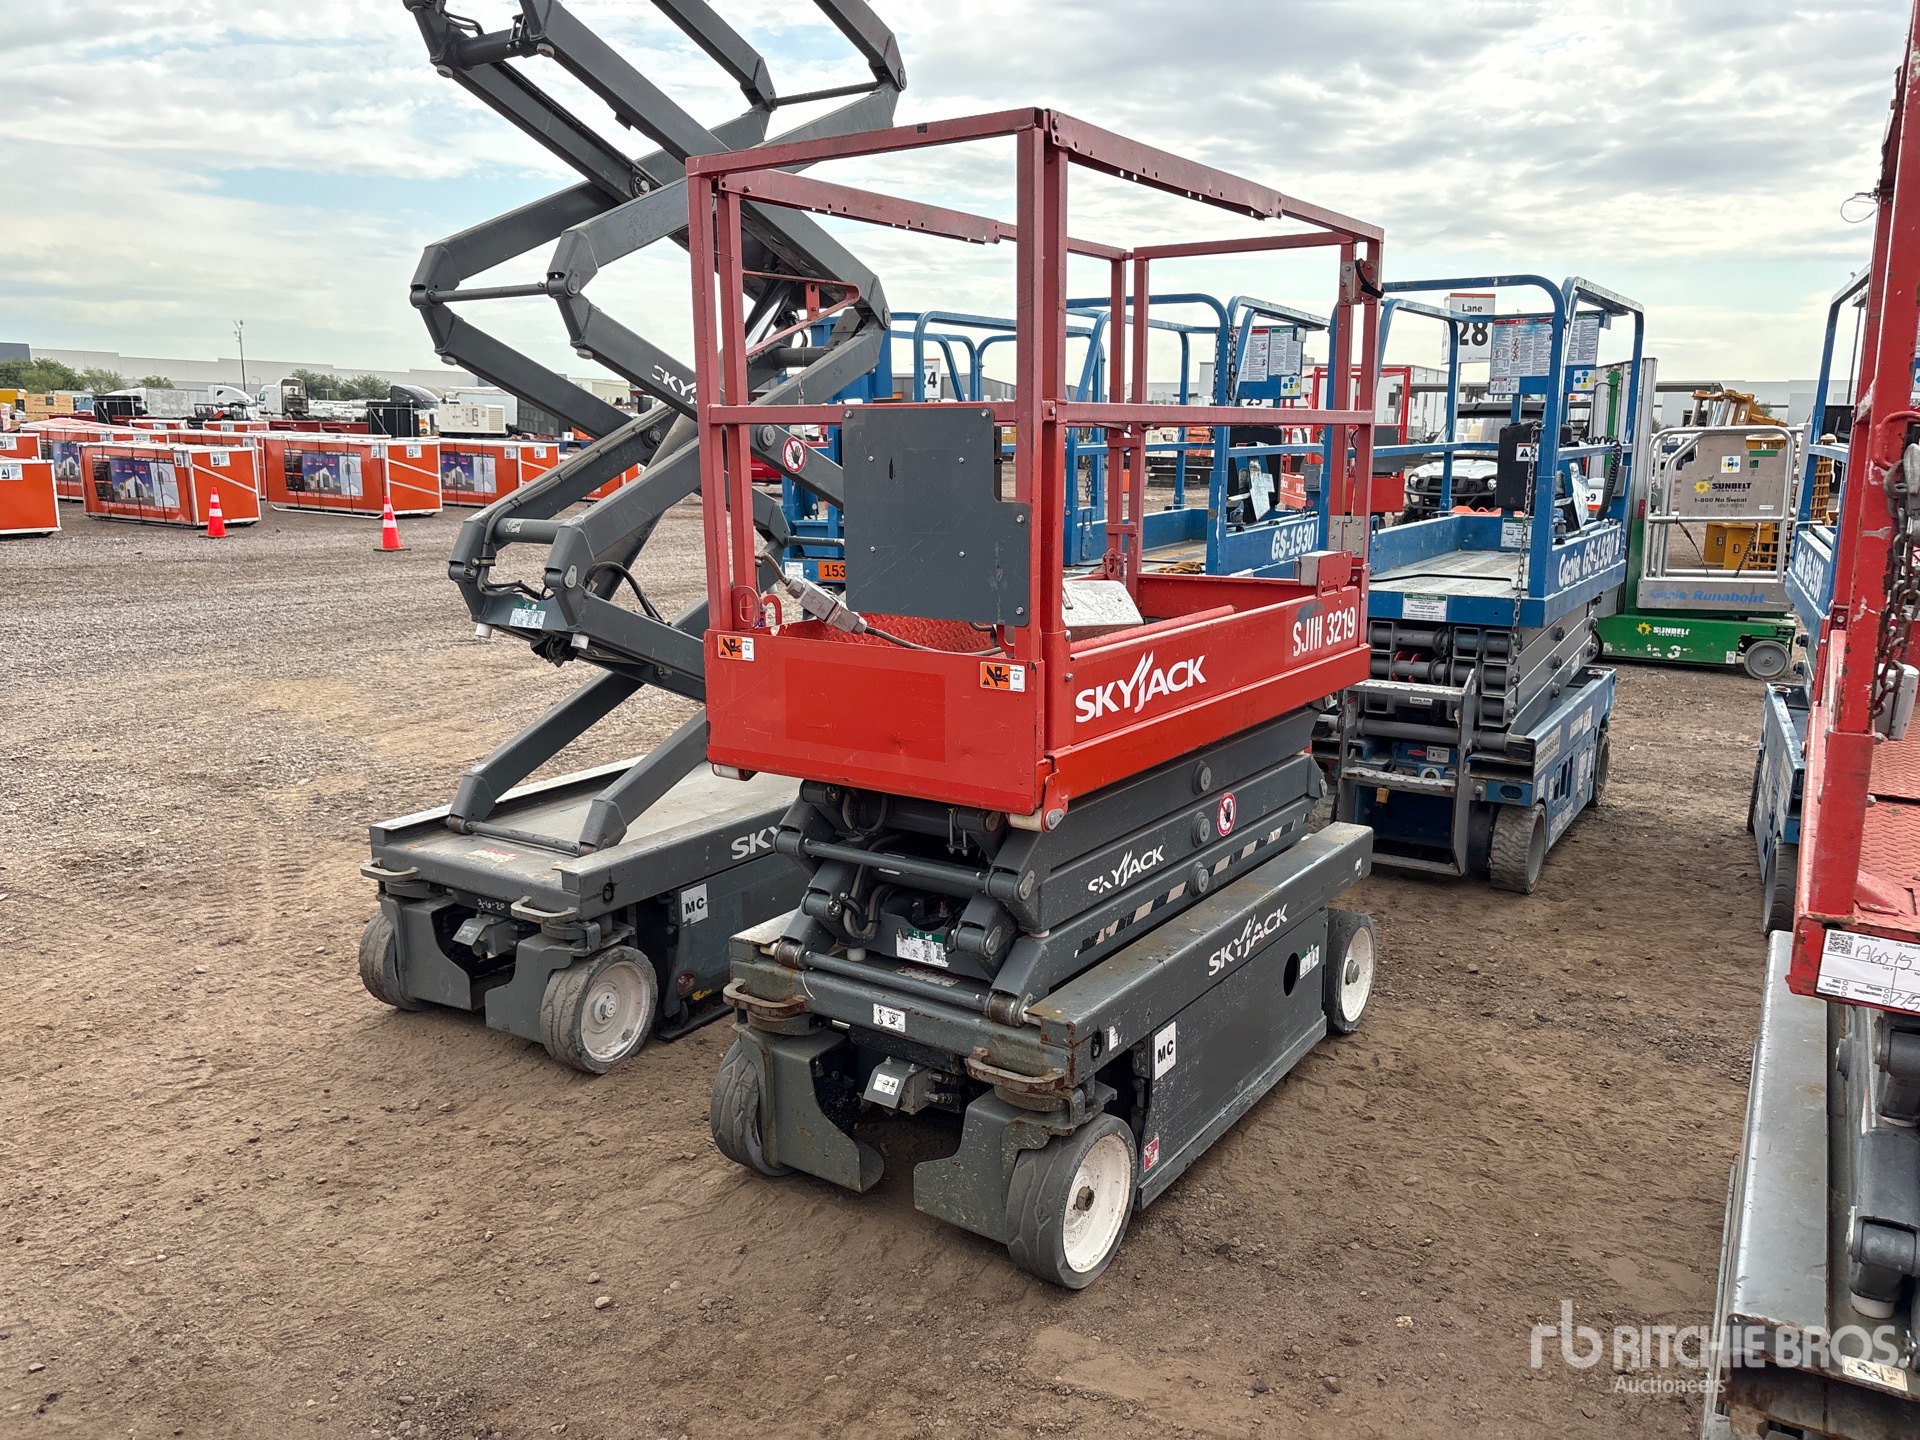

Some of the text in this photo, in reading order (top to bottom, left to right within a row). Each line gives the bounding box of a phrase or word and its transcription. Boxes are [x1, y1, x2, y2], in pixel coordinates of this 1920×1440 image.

[1462, 303, 1483, 313] Lane
[1459, 321, 1489, 347] 28
[1712, 482, 1752, 490] SUNBELT
[1271, 522, 1315, 561] GS-1930
[1558, 532, 1615, 587] Genie GS-1930
[1692, 589, 1765, 604] Runabout
[1326, 606, 1356, 646] 3219
[1075, 650, 1207, 723] SKYJACK
[1088, 844, 1165, 894] SKYJACK
[685, 897, 705, 915] MC
[1208, 903, 1288, 977] SKYJACK
[1157, 1039, 1174, 1064] MC
